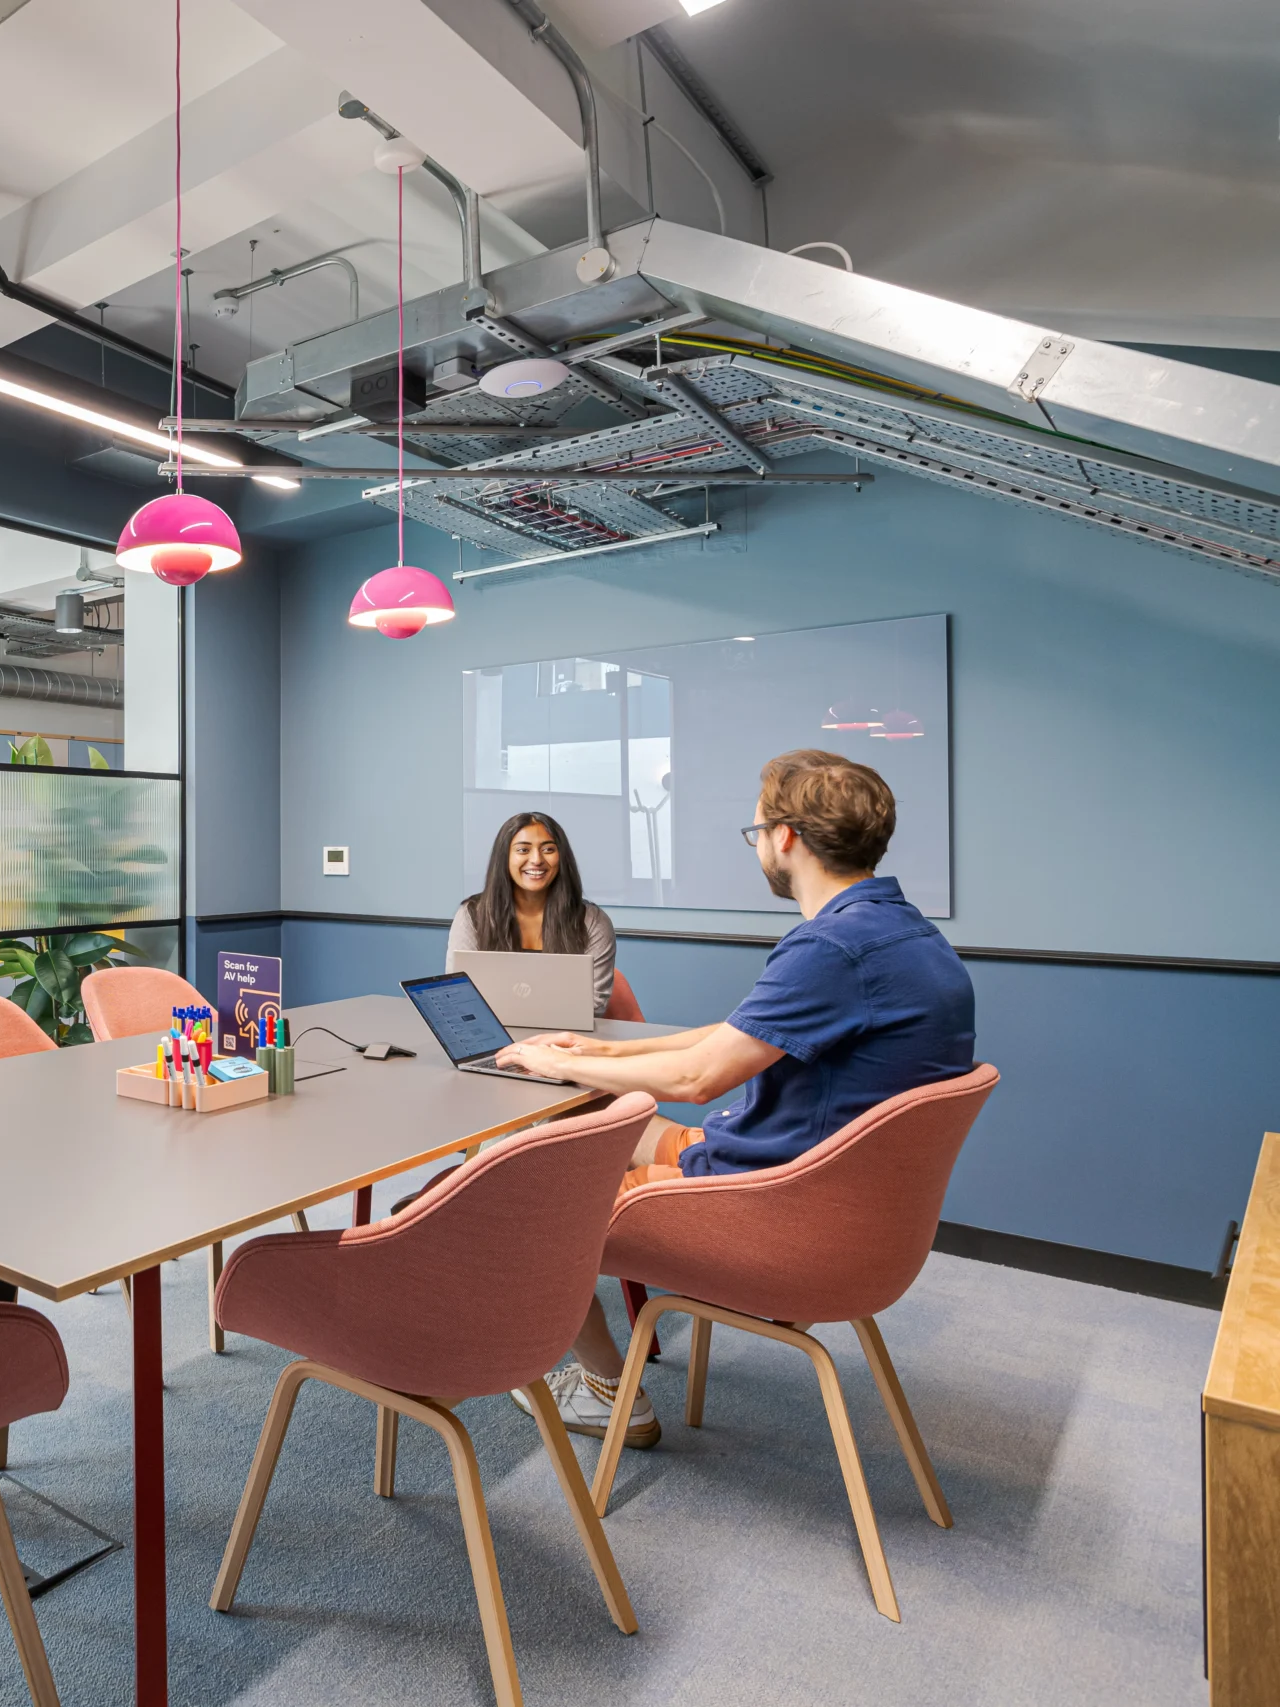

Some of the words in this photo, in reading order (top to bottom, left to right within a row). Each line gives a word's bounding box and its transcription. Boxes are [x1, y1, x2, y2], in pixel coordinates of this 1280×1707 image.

[224, 960, 245, 970] Scan
[246, 961, 259, 972] for
[224, 971, 236, 981] AV
[237, 972, 256, 985] help
[513, 982, 531, 998] hp
